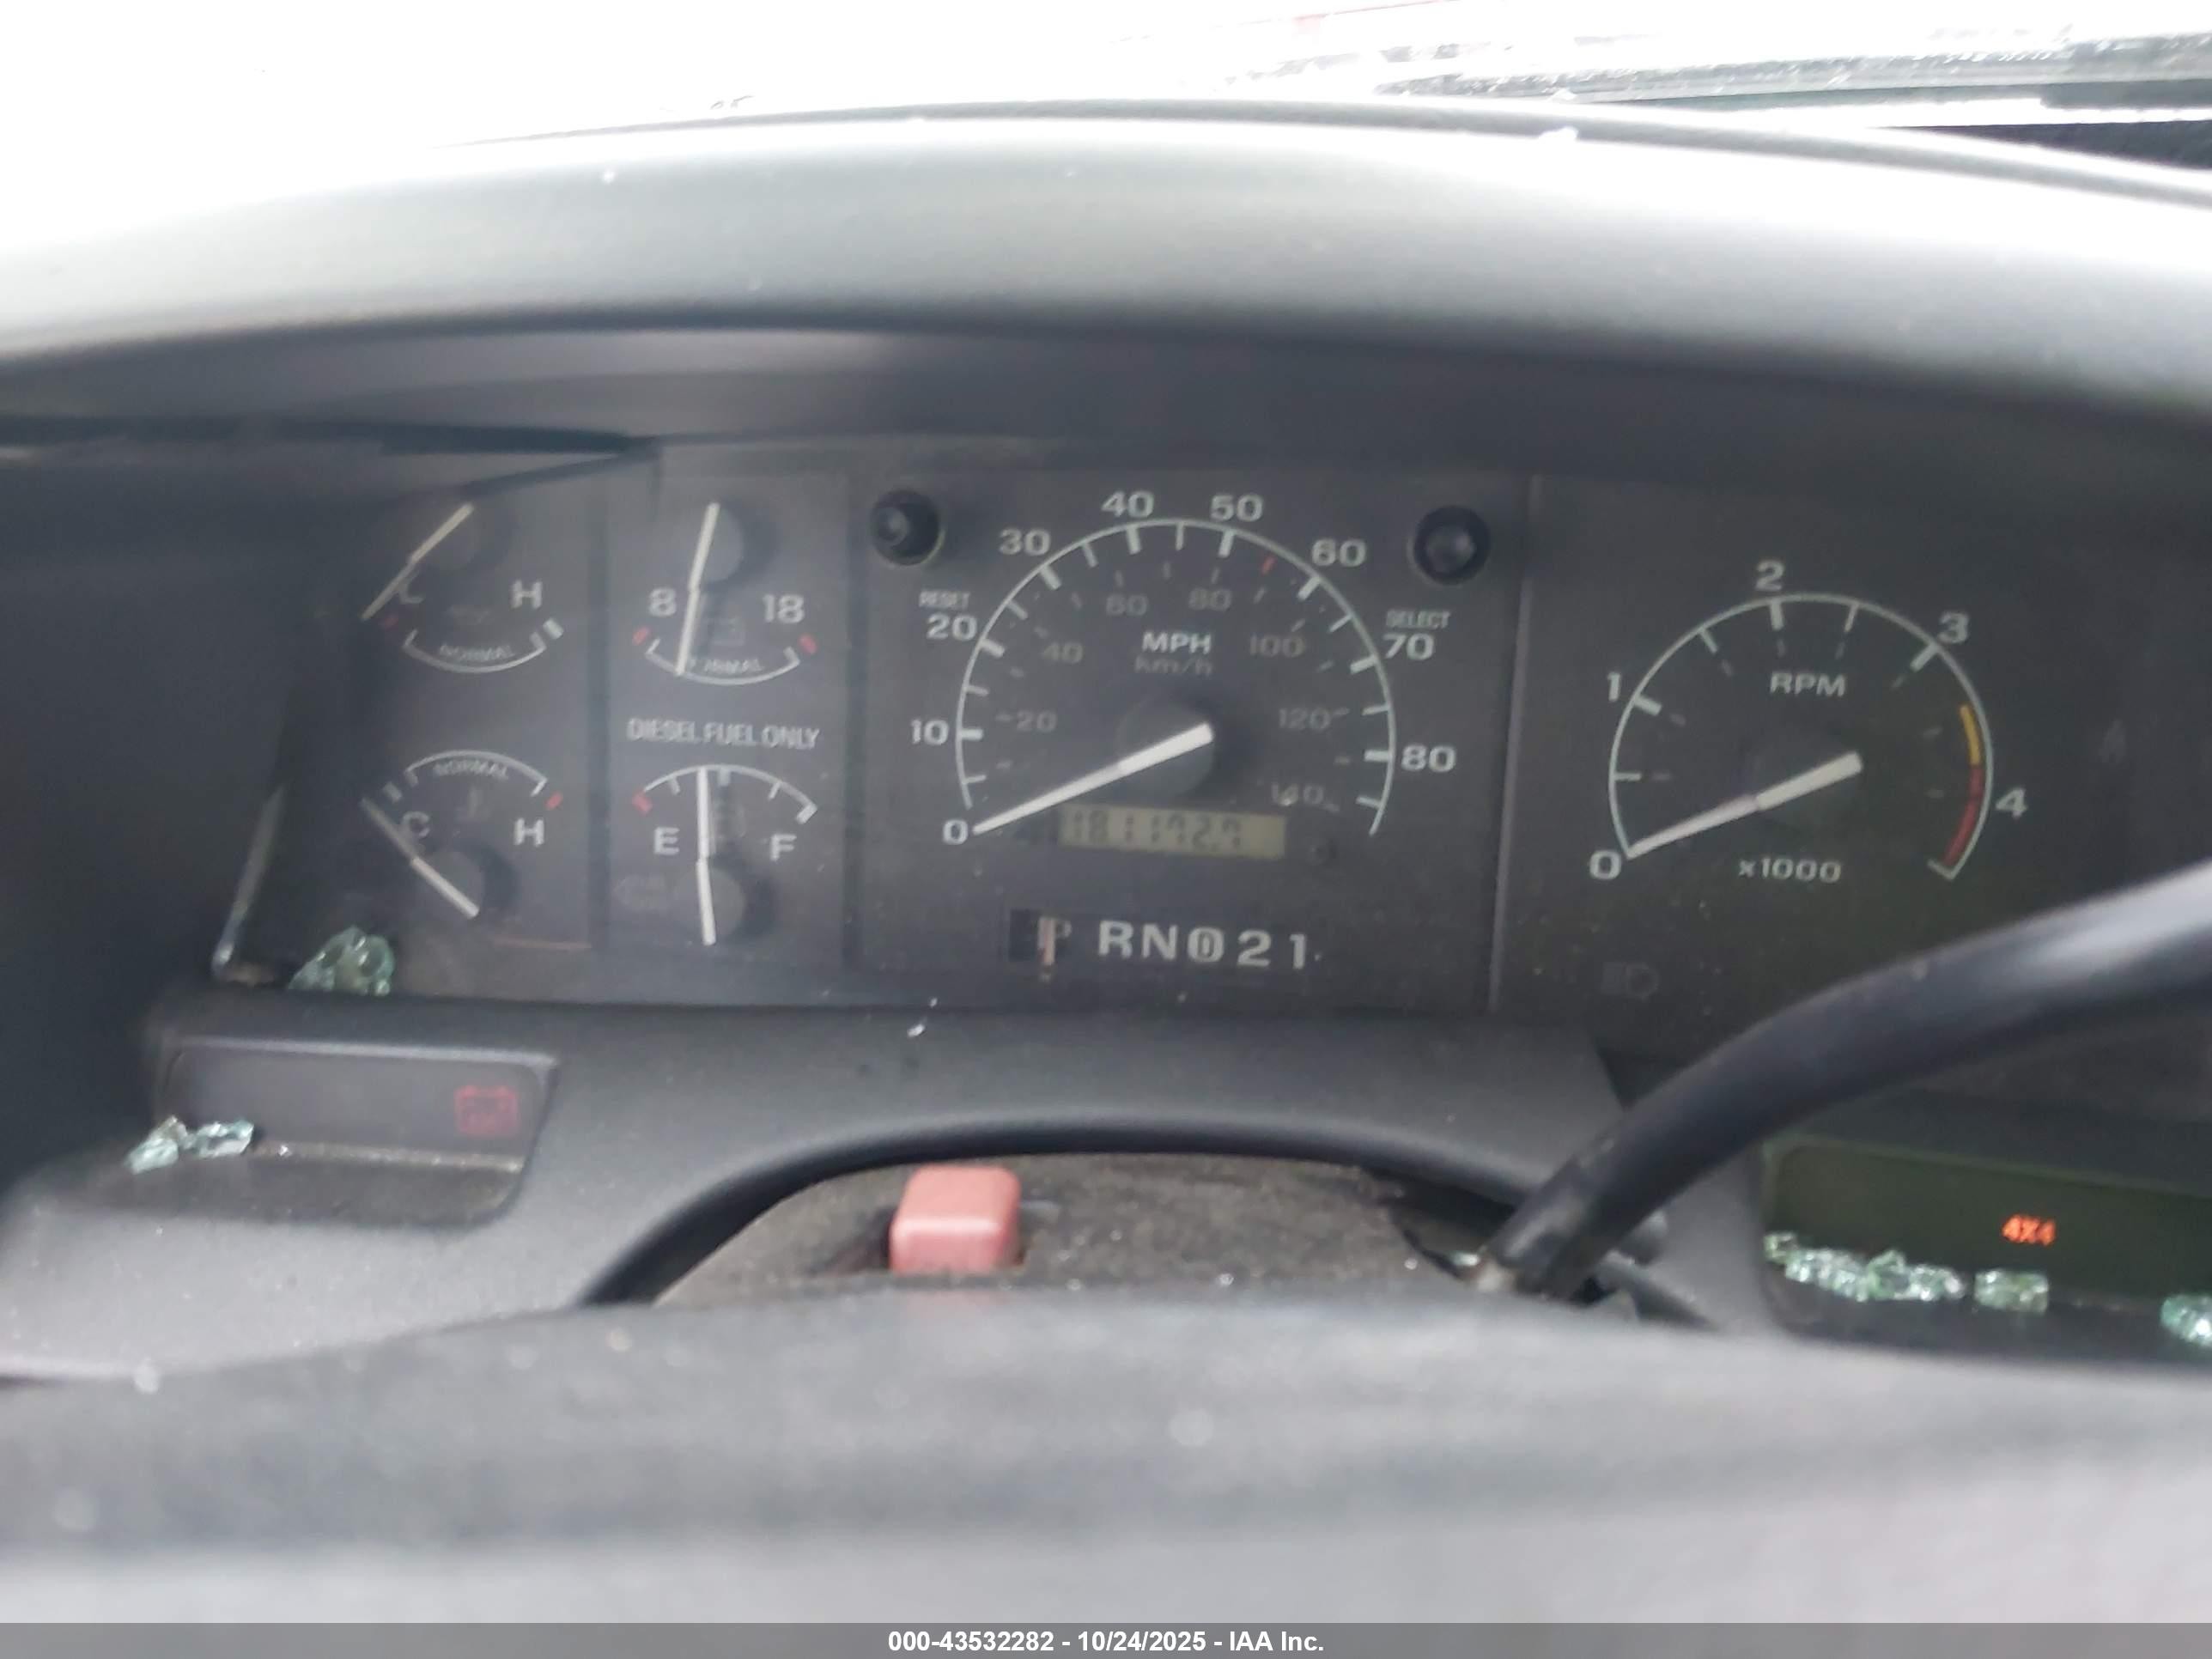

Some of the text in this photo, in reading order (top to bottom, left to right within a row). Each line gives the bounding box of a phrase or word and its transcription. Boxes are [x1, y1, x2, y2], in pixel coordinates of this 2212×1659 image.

[1102, 491, 1154, 518] 40
[1211, 494, 1263, 522] 50
[1000, 527, 1051, 556] 30
[1312, 539, 1366, 567] 60
[1756, 561, 1784, 591] 2
[511, 580, 542, 609] H
[649, 587, 677, 617] 8
[763, 593, 805, 623] 18
[927, 613, 977, 641] 20
[1938, 612, 1968, 645] 3
[1142, 631, 1212, 655] MPH
[1249, 634, 1306, 658] 100
[1382, 633, 1435, 660] 70
[1607, 673, 1620, 702] 1
[1769, 672, 1846, 697] RPM
[628, 718, 820, 750] DIESEL FUEL ONLY
[911, 719, 948, 744] 10
[1401, 744, 1456, 773] 80
[1996, 787, 2027, 818] 4
[514, 818, 545, 846] H
[654, 827, 680, 855] E
[943, 819, 969, 844] 0
[770, 834, 797, 861] F
[1589, 850, 1621, 880] 0
[1738, 857, 1841, 884] x1000
